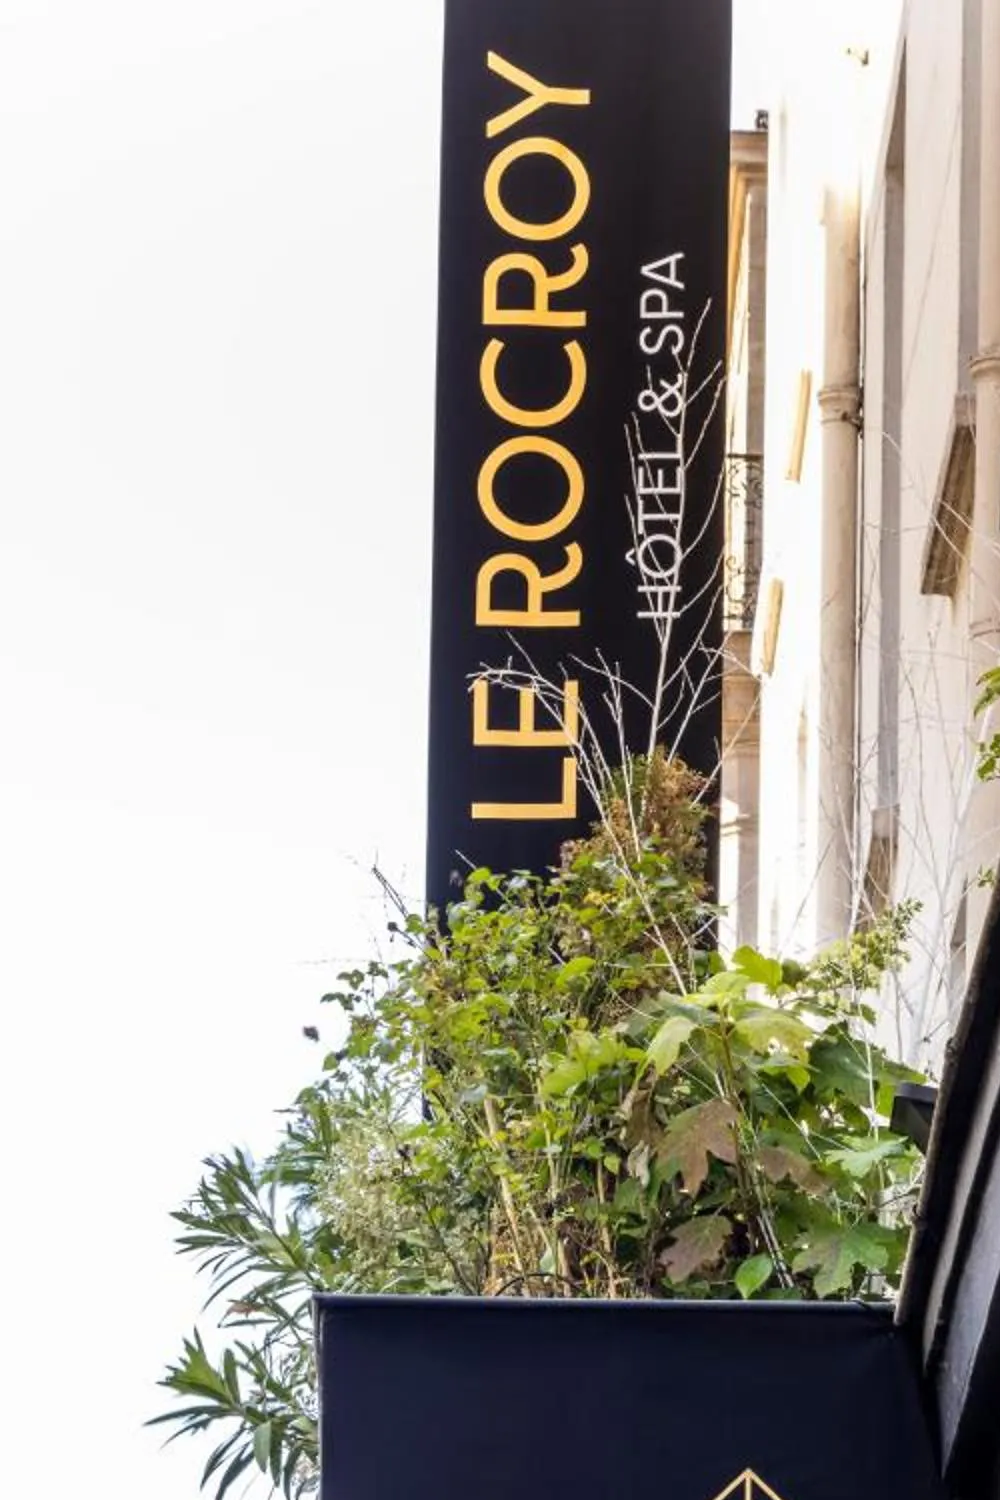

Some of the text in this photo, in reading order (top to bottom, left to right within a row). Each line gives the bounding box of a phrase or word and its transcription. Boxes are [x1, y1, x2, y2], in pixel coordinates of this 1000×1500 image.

[472, 50, 592, 819] LE ROCROY
[625, 251, 685, 619] HÔTEL & SPA
